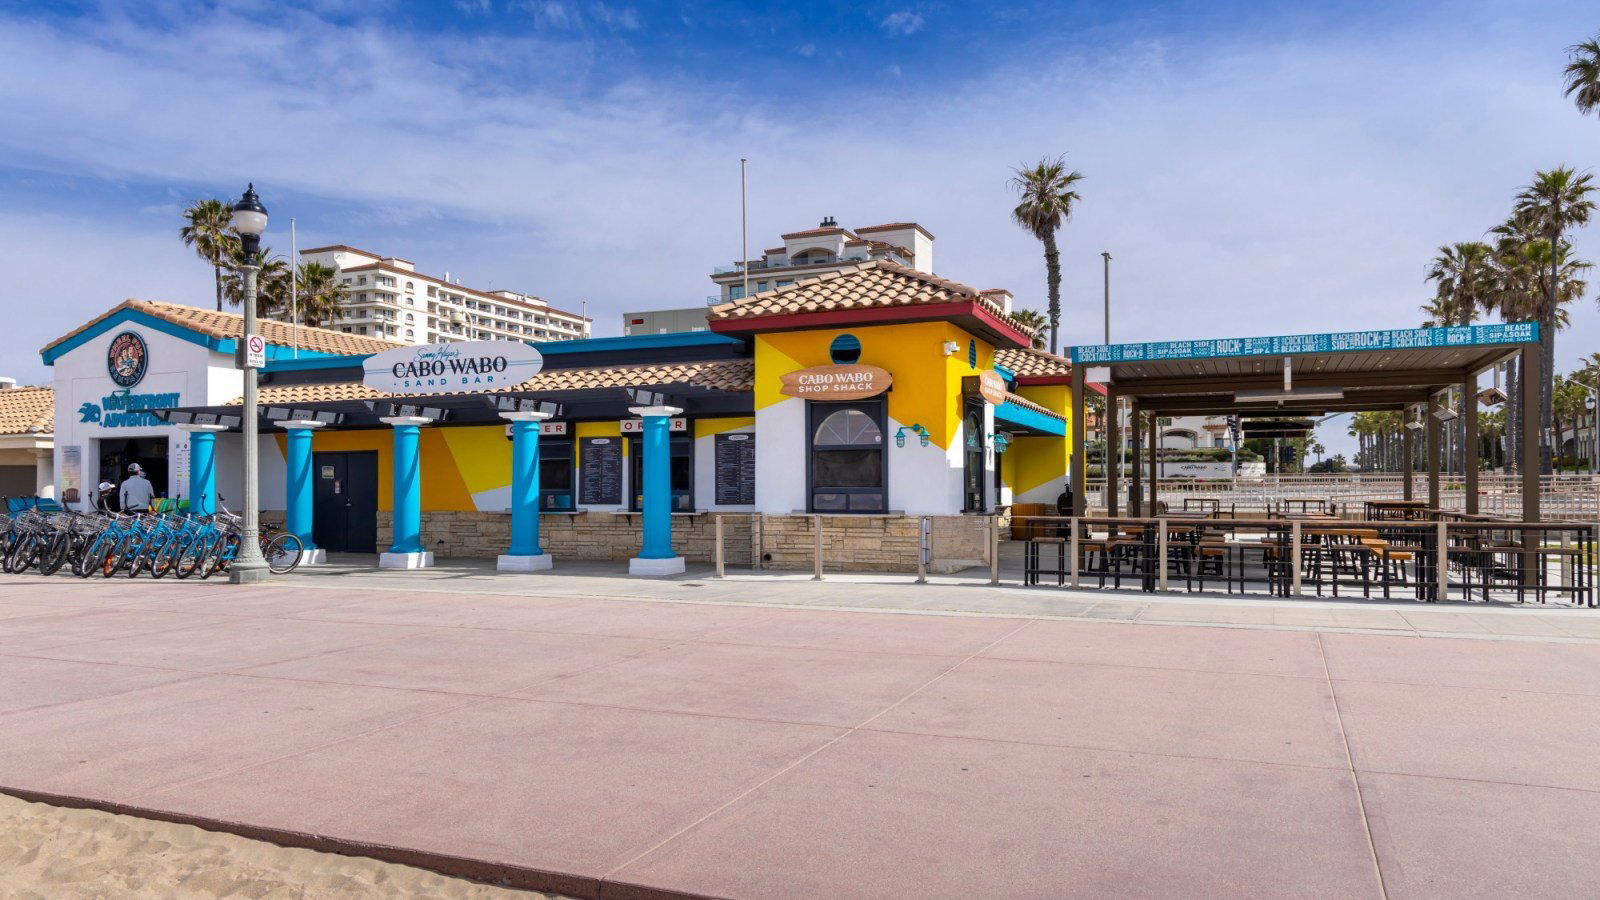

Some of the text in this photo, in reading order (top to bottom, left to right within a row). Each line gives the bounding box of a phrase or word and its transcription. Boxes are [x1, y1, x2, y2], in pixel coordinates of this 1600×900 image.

[1505, 324, 1531, 332] BEACH
[1284, 334, 1319, 346] COCKTAILS
[1331, 340, 1350, 350] SIDE
[1355, 332, 1379, 347] ROCK
[1396, 336, 1432, 347] COCKTAILS
[1217, 340, 1240, 354] ROCK
[392, 356, 508, 378] CABO WABO
[404, 375, 494, 388] SAND BAR
[798, 372, 873, 385] CABO WABO
[798, 383, 873, 393] SHOP SHACK
[102, 393, 180, 410] WATERFRONT
[624, 420, 682, 430] ORR
